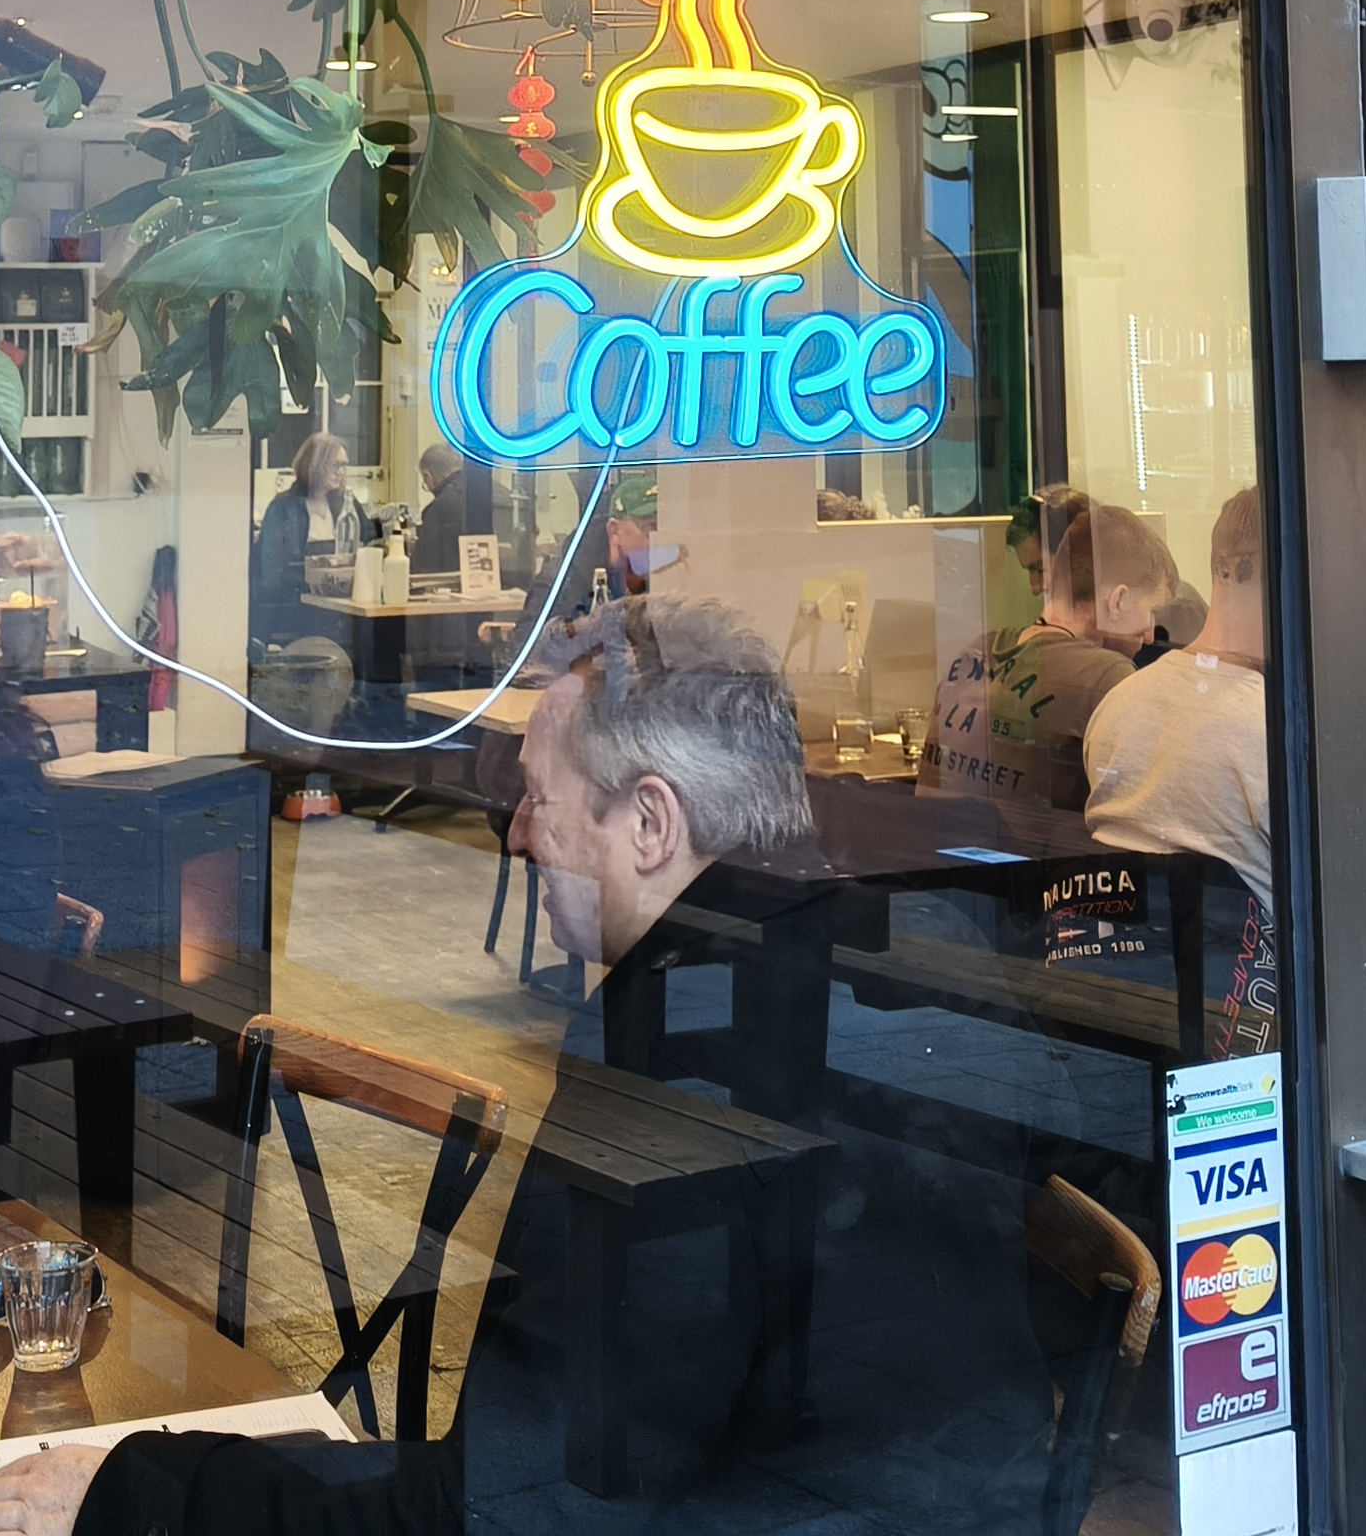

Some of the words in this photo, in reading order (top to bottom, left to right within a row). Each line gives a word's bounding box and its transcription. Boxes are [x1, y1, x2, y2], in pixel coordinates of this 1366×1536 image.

[459, 269, 935, 459] Coffee
[948, 752, 1025, 790] STREET
[1043, 870, 1136, 912] NAUTICA
[1195, 1116, 1213, 1128] We
[1215, 1108, 1257, 1124] welcome
[1185, 1157, 1268, 1206] VISA
[1183, 1260, 1276, 1301] MasterCard
[1196, 1389, 1268, 1423] eftpos
